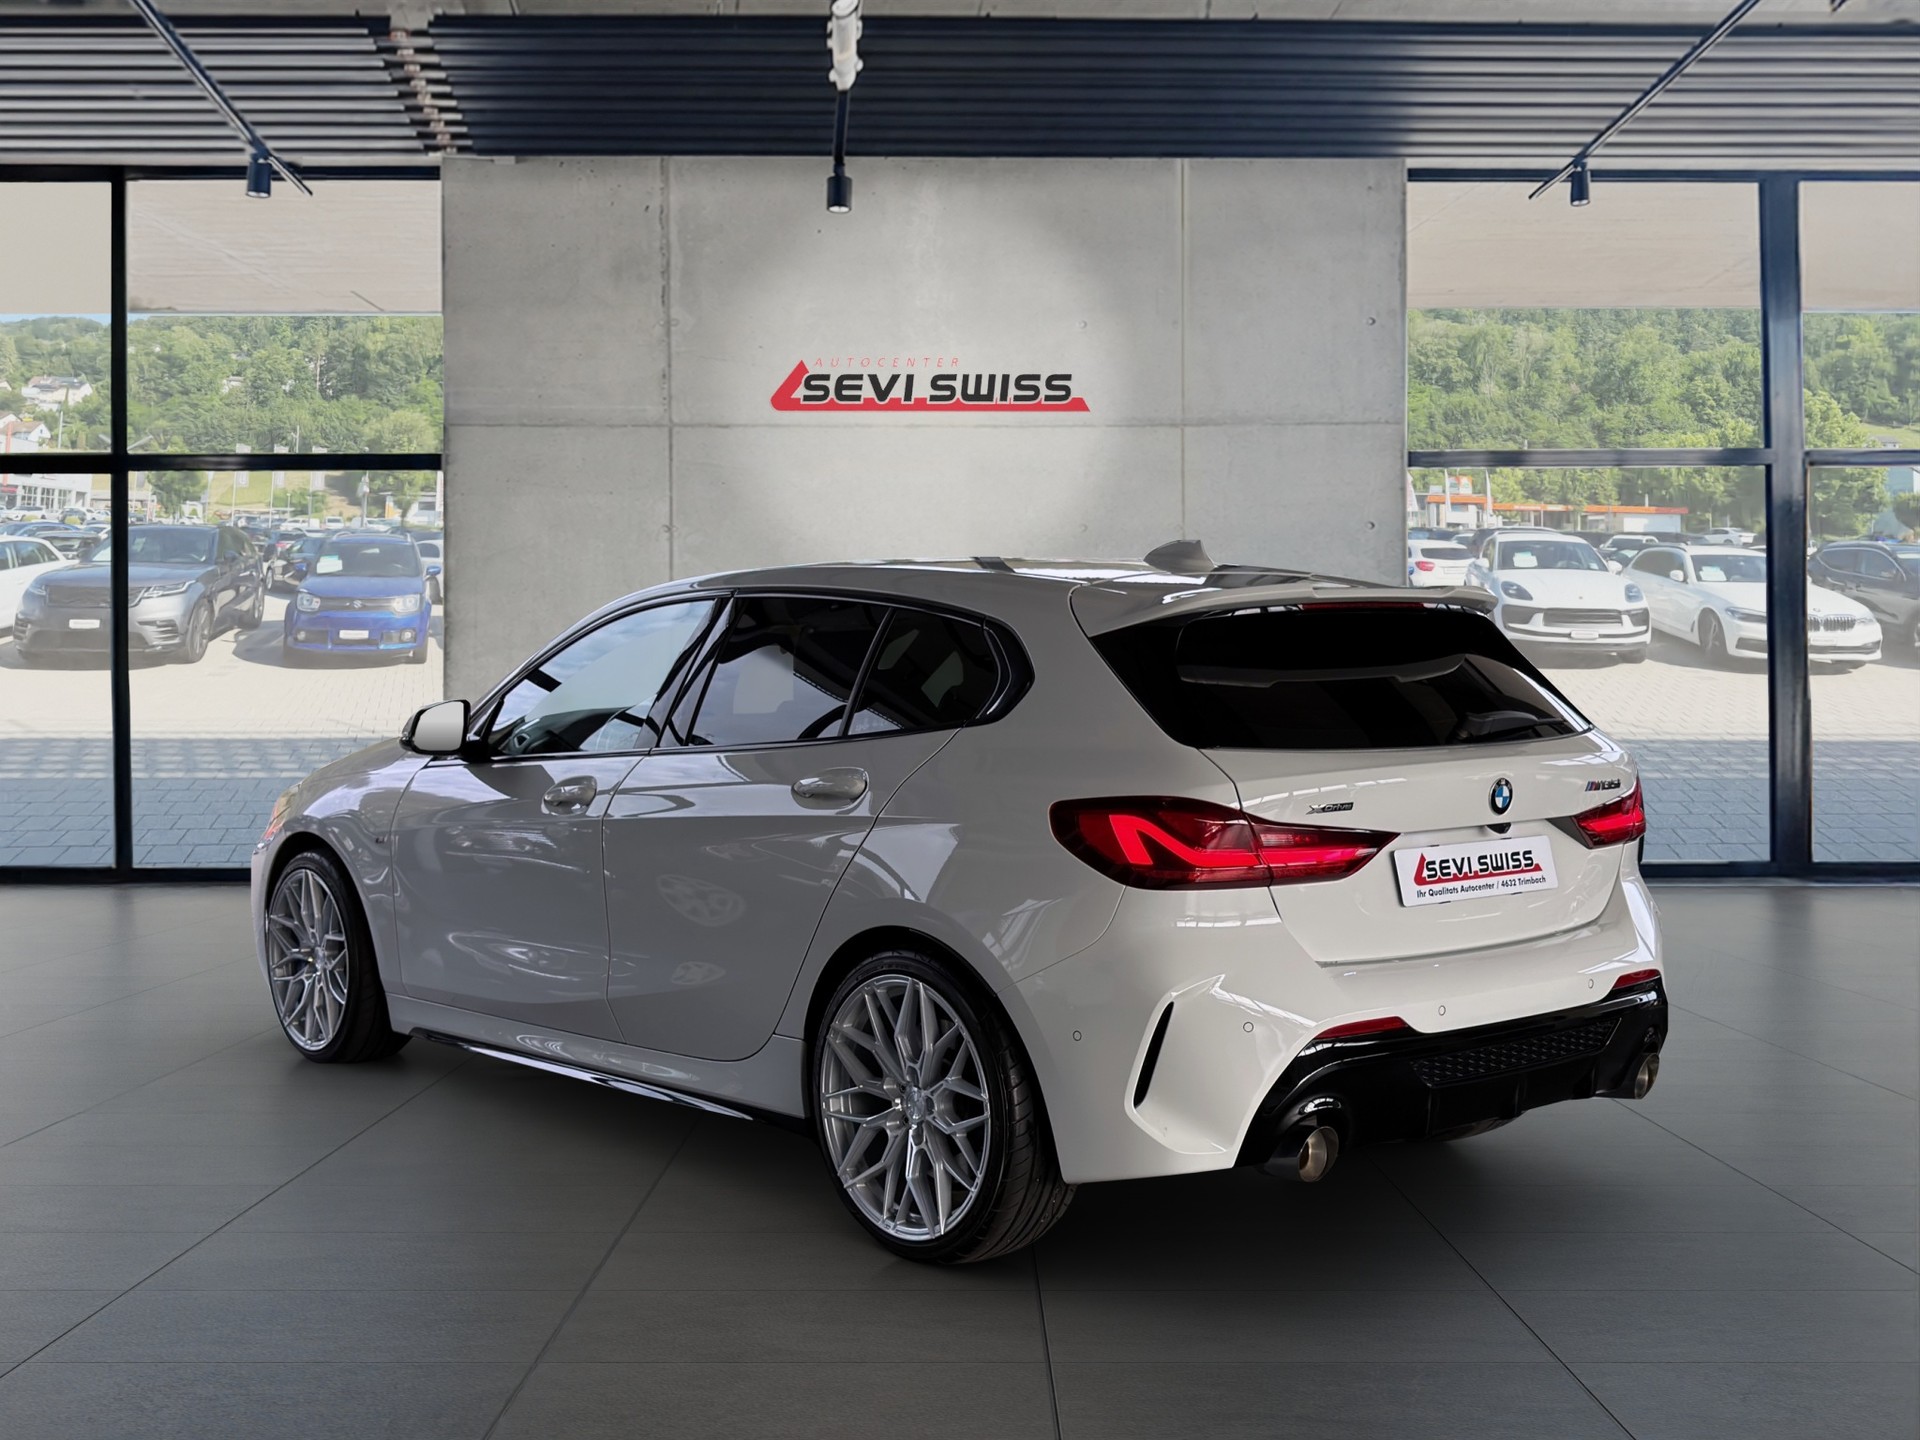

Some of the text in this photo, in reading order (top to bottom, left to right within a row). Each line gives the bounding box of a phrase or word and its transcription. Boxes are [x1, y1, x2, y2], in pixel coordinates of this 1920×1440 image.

[813, 357, 960, 368] AUTOCENTER
[802, 374, 1072, 402] SEVI SWISS
[1425, 850, 1534, 879] SEVI SWISS
[1416, 889, 1427, 898] Ihr
[1460, 882, 1495, 893] Autocenter
[1501, 879, 1517, 888] 4632
[1518, 875, 1547, 886] Trimbach
